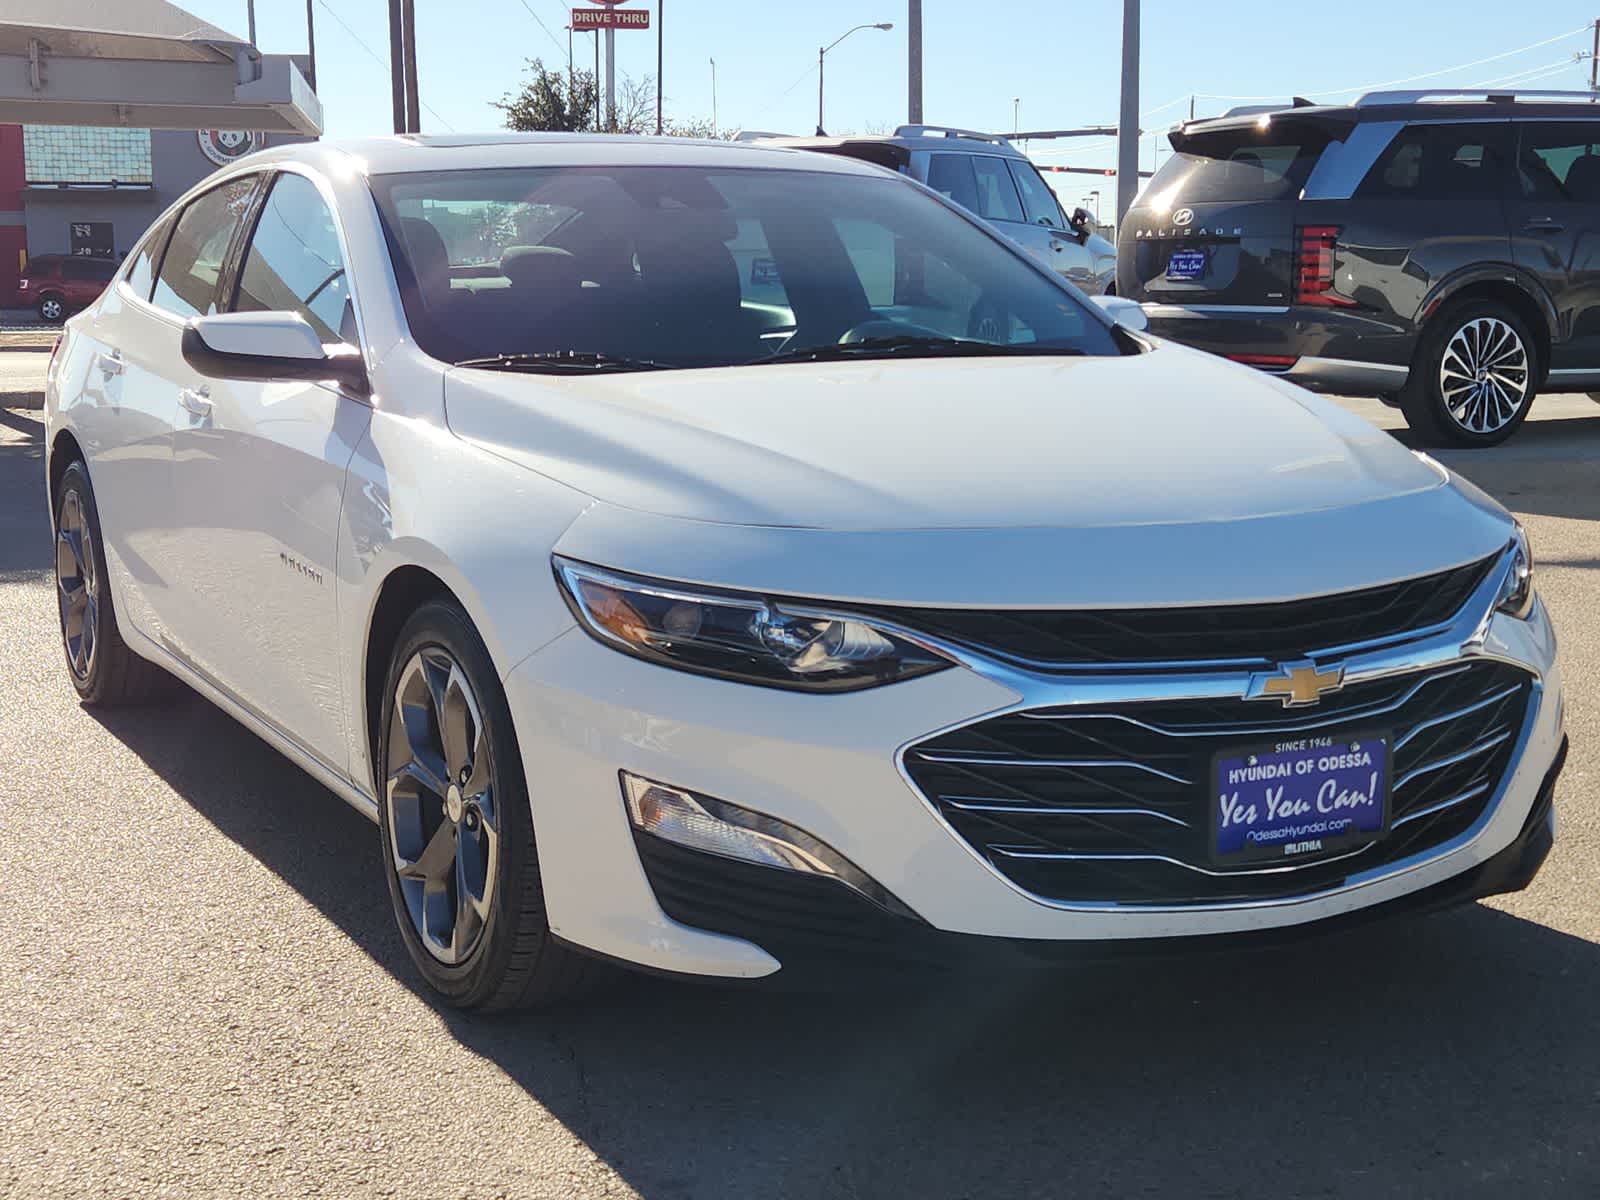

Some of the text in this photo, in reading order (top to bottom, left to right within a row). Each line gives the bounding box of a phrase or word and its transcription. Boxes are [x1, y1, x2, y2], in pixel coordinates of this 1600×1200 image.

[574, 13, 648, 24] DRIVE THRU
[1275, 740, 1305, 753] SINCE
[1229, 752, 1372, 784] HYUNDAI OF ODESSA
[1220, 771, 1378, 828] Yes You Can!
[1294, 840, 1322, 853] LITHIA
